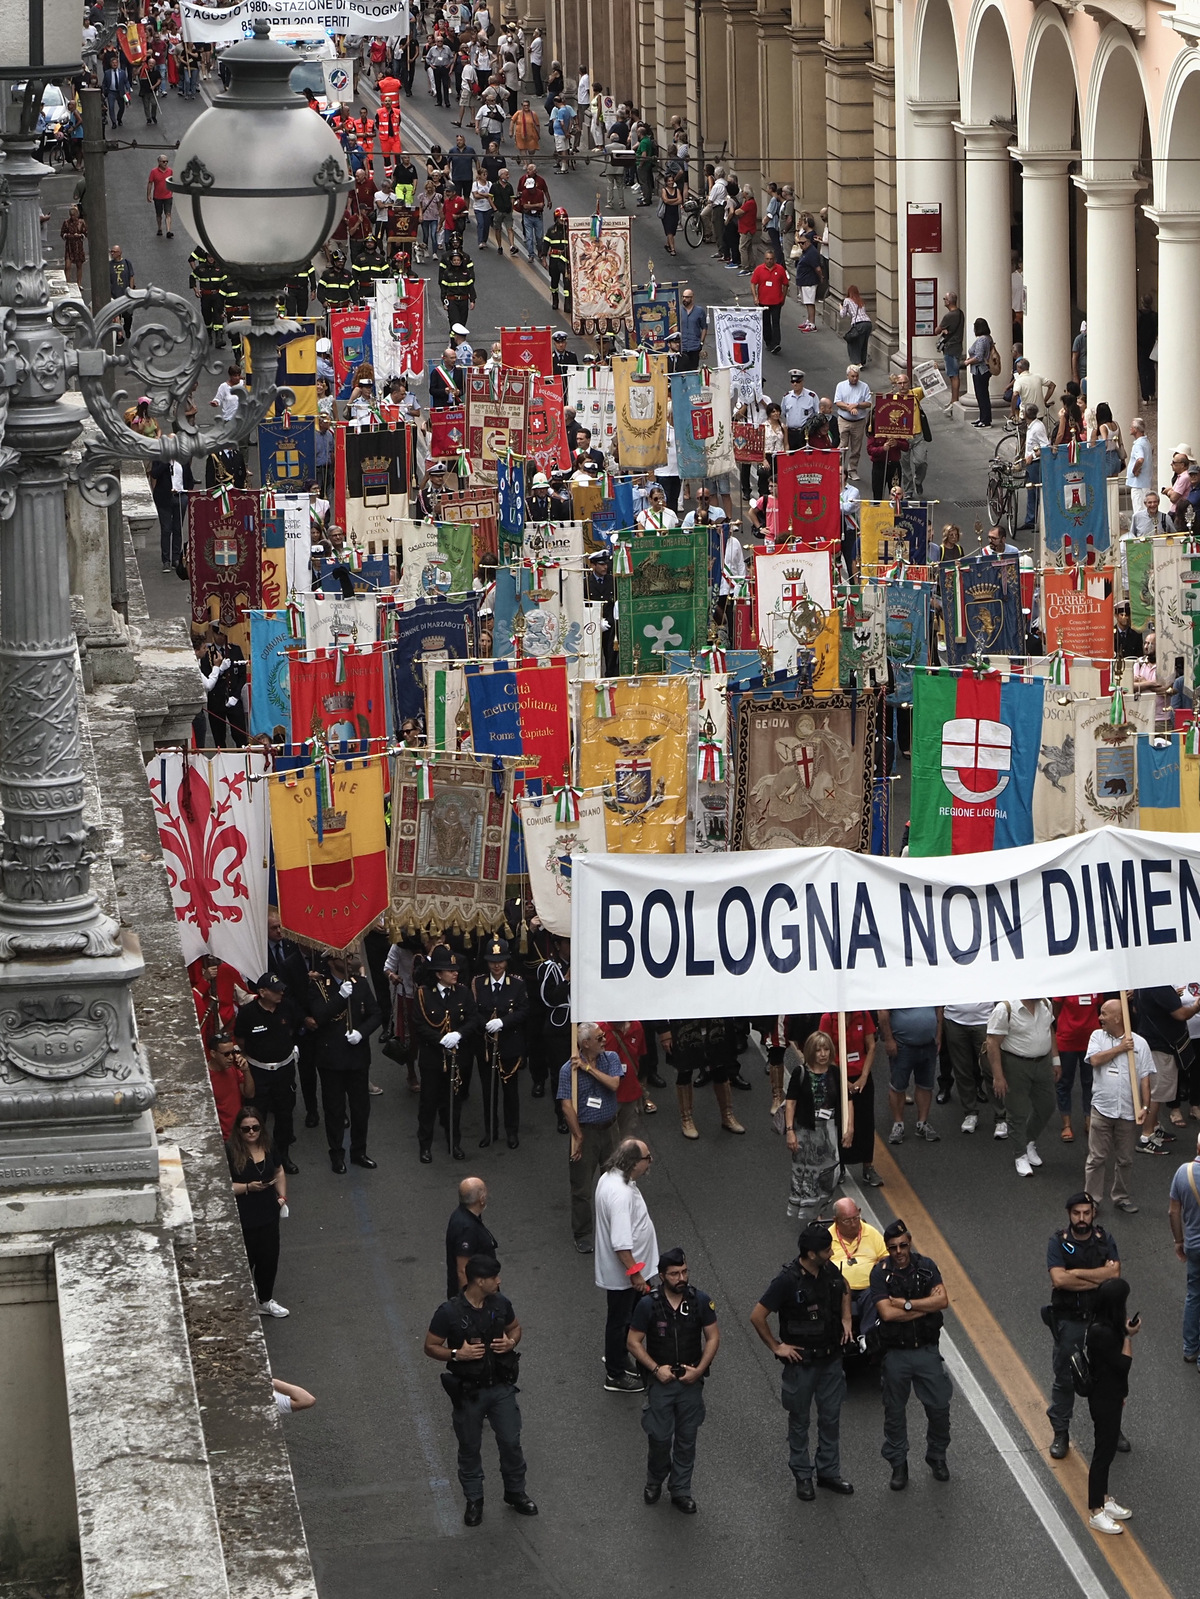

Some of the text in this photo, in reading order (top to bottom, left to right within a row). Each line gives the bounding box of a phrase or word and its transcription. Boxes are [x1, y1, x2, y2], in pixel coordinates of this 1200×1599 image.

[184, 0, 405, 20] 2 AGOSTO 1980: STAZIONE DI BOLOGNA
[241, 20, 252, 32] 85
[255, 17, 291, 26] RTI
[317, 16, 350, 27] FERITI
[208, 517, 242, 528] BELLUNO
[905, 514, 925, 527] PARMA
[329, 602, 352, 610] COMUNE
[1046, 592, 1087, 606] TERRE
[1048, 603, 1102, 619] CASTELLI
[260, 632, 288, 661] COMUNE
[504, 682, 531, 696] Città
[1044, 691, 1089, 704] EGIONE
[482, 697, 558, 718] metropolitana
[516, 717, 525, 727] di
[1043, 708, 1075, 722] OSCA
[1080, 709, 1150, 730] PROVINC BIELLA
[755, 718, 790, 729] GENOVA
[489, 726, 555, 741] Roma Capitale
[293, 781, 359, 805] CONE
[526, 814, 553, 827] COMUNE
[939, 807, 1008, 820] REGIONE LIGURIA
[304, 893, 370, 919] NAPOLI
[600, 881, 888, 981] BOLOGNA
[899, 878, 1025, 968] NON
[31, 1040, 83, 1057] 1896
